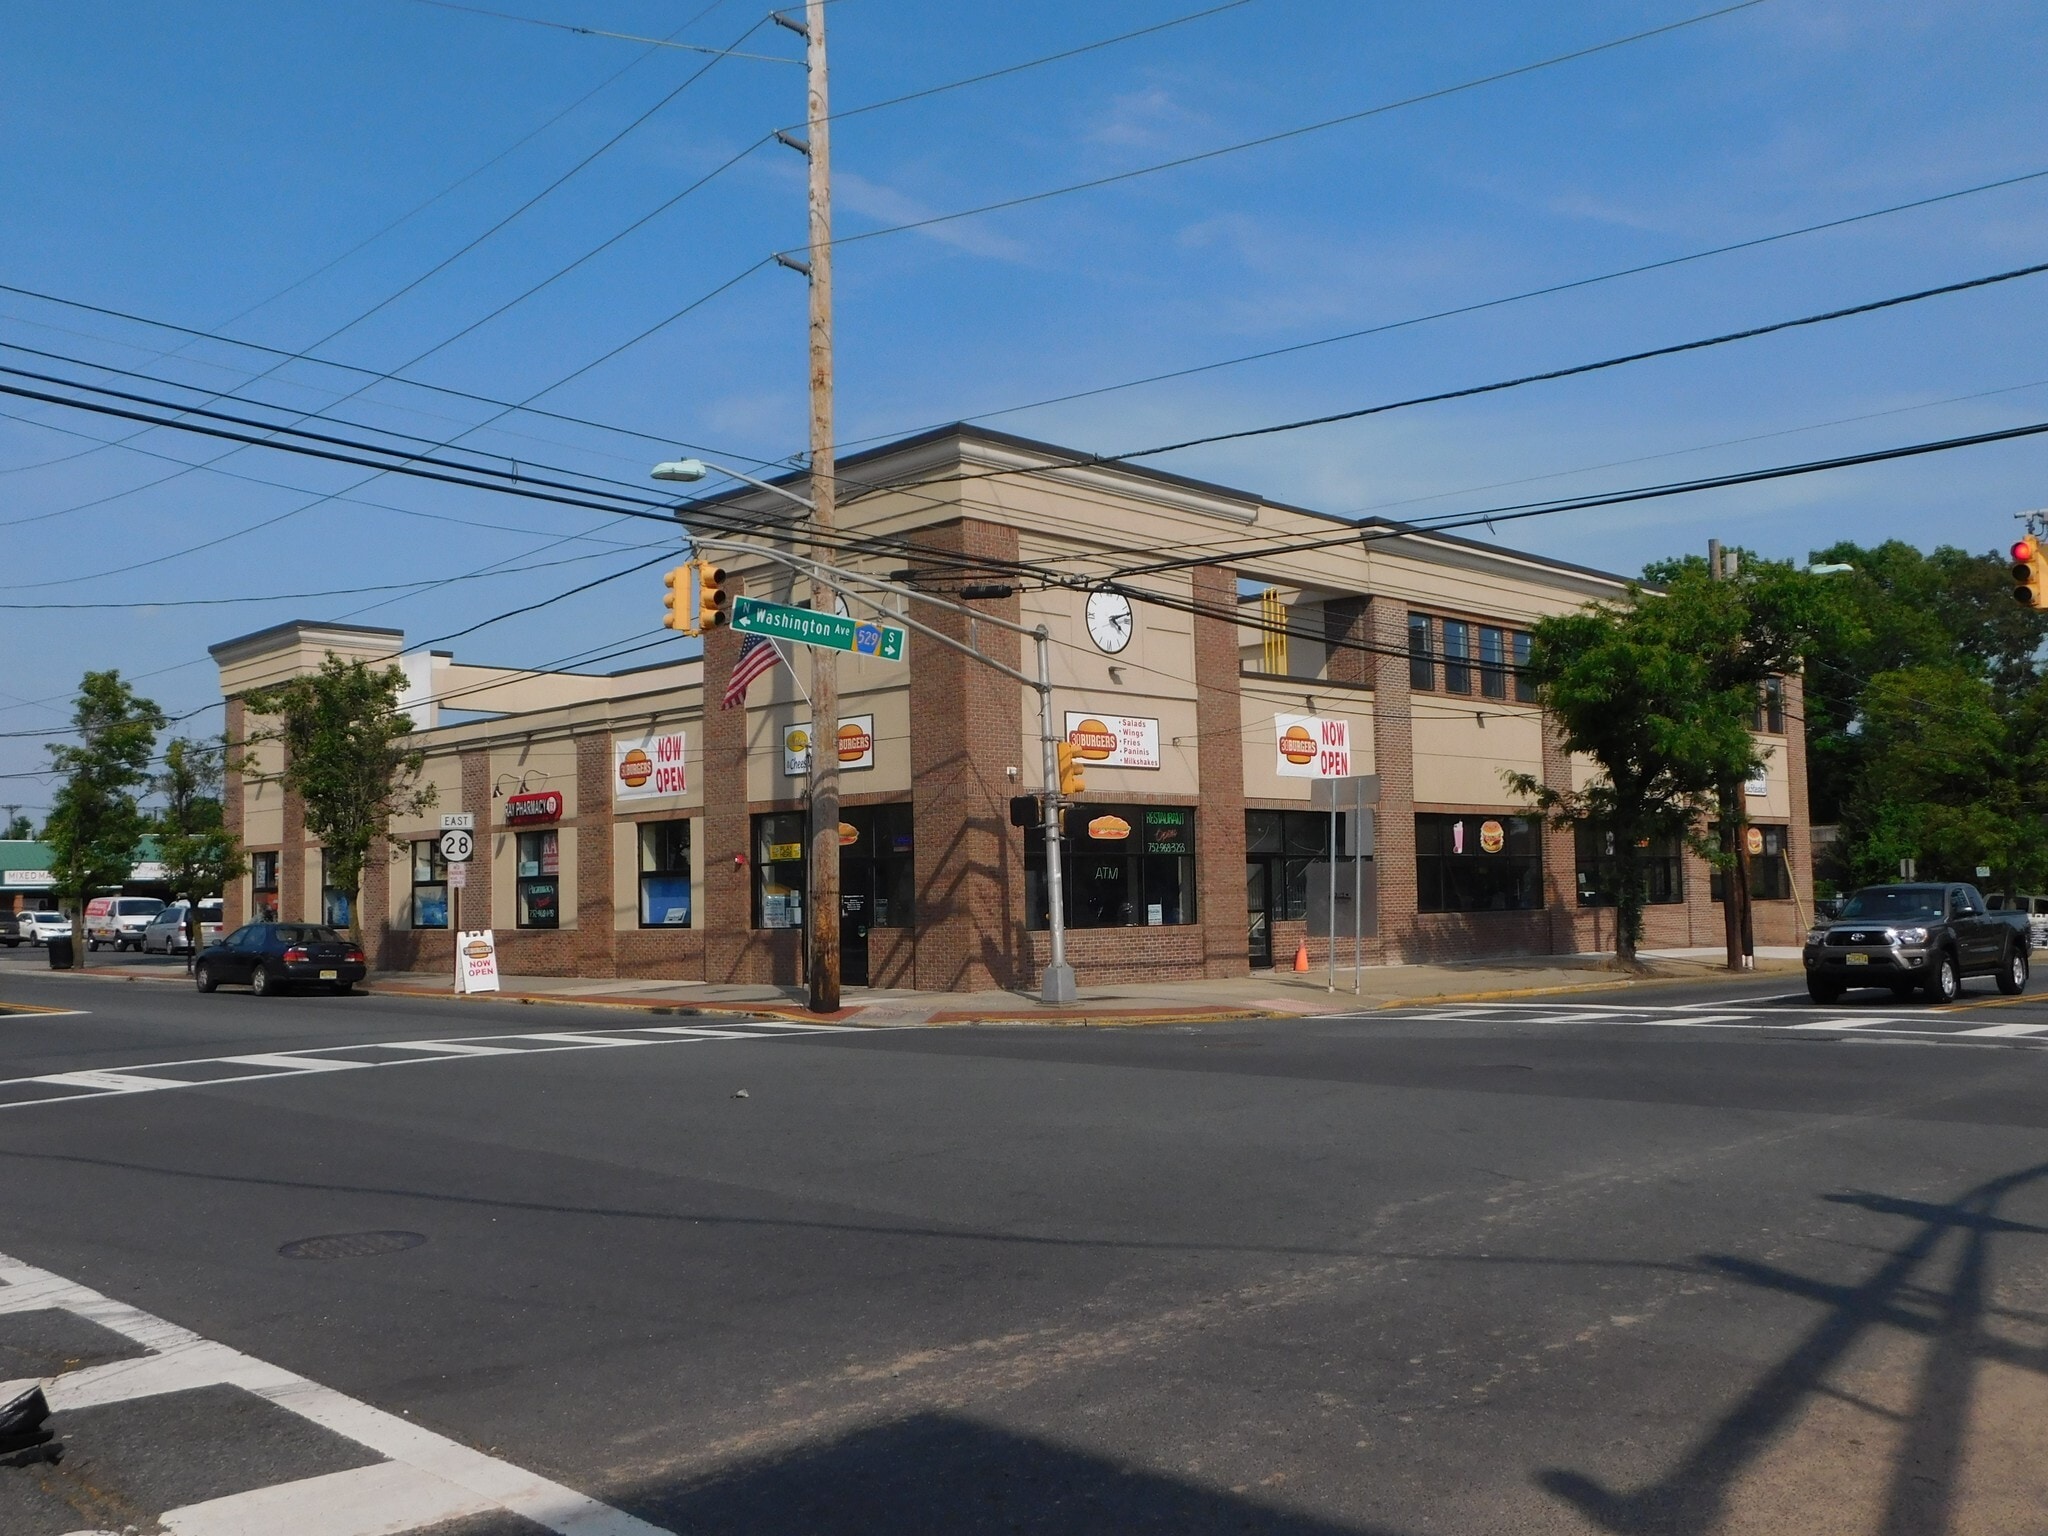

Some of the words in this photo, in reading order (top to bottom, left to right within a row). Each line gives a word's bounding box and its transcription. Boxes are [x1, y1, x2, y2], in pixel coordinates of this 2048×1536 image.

[743, 602, 750, 613] N
[756, 607, 830, 636] Washington
[835, 623, 850, 636] Ave
[858, 630, 878, 646] 529
[888, 631, 895, 643] S
[1122, 718, 1146, 728] Salads
[1122, 728, 1144, 738] Wings
[1321, 721, 1345, 747] NOW
[1123, 738, 1141, 747] Fries
[657, 735, 682, 763] NOW
[1123, 747, 1150, 756] Paninis
[1123, 757, 1158, 767] Milkshakes
[1320, 750, 1348, 776] OPEN
[656, 765, 686, 794] OPEN
[505, 803, 515, 817] RAY
[516, 799, 547, 816] PHARMACY
[445, 816, 468, 826] EAST
[1146, 811, 1185, 825] RESTAURANT
[445, 836, 469, 854] 28
[8, 871, 37, 880] MIXED
[1095, 867, 1119, 880] ATM
[469, 959, 491, 968] NOW
[468, 968, 494, 977] OPEN
